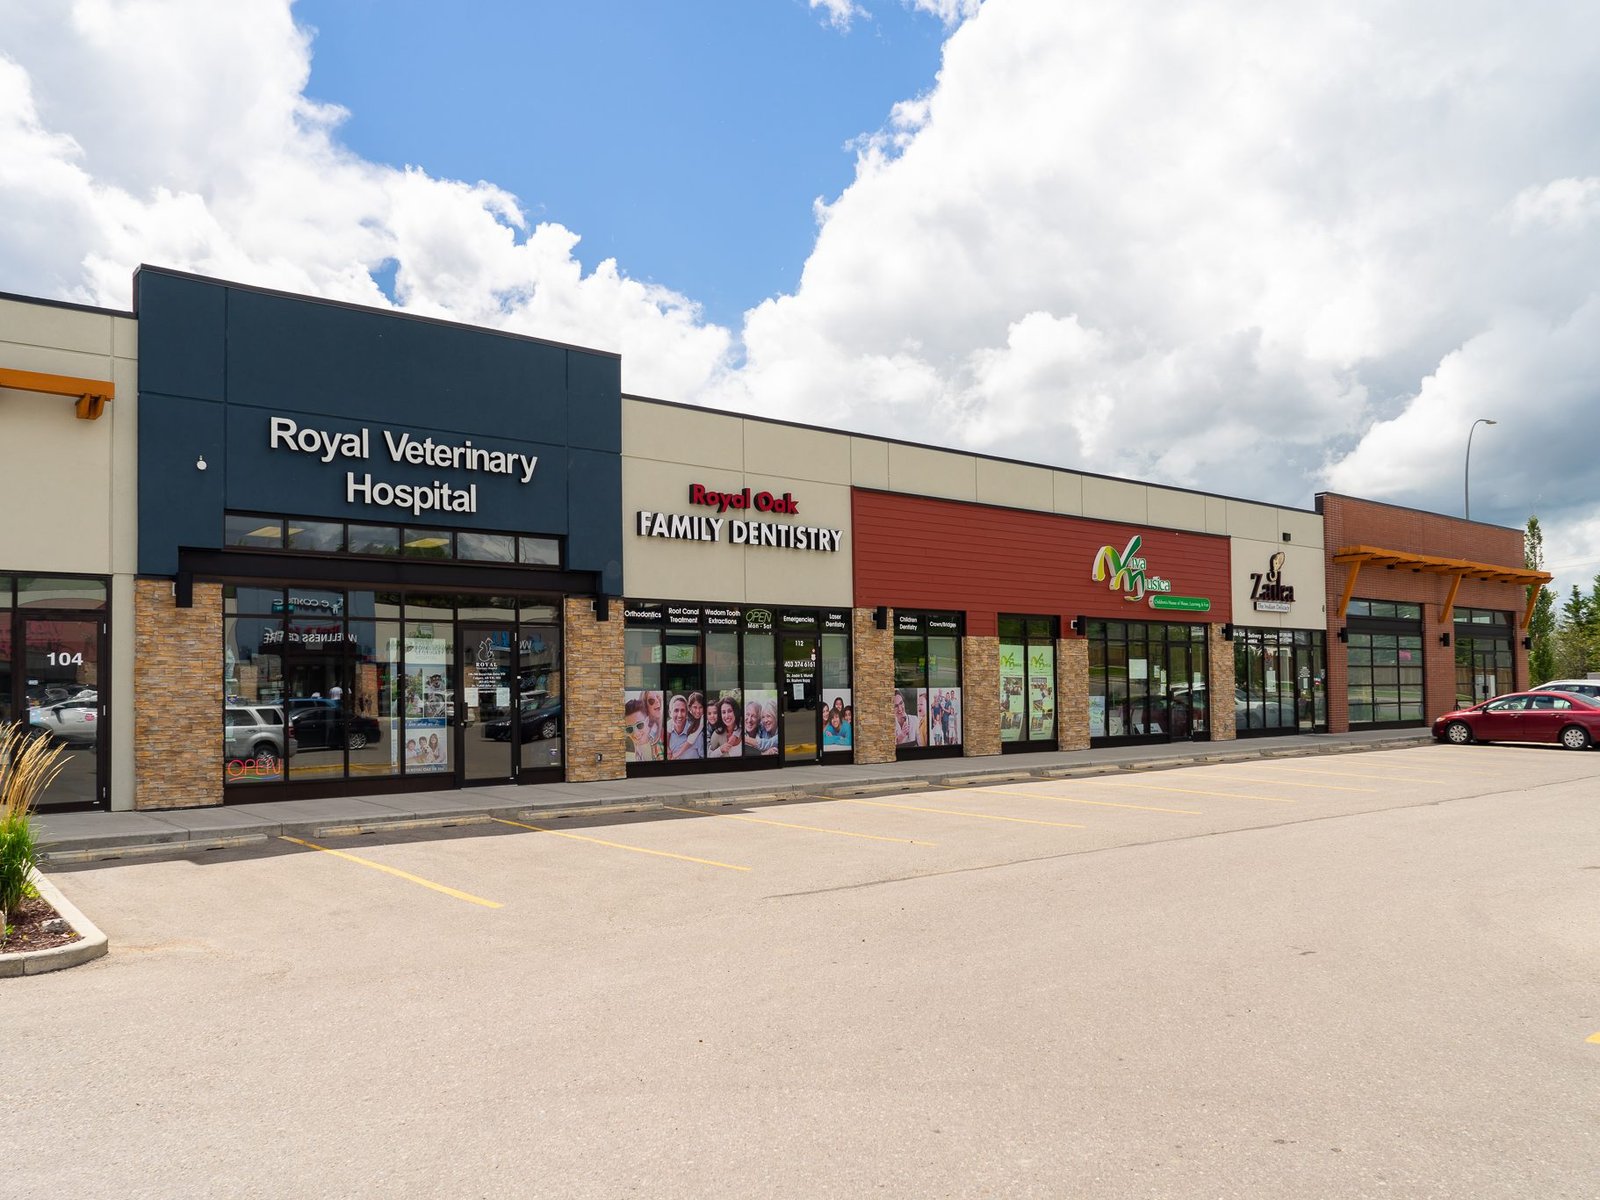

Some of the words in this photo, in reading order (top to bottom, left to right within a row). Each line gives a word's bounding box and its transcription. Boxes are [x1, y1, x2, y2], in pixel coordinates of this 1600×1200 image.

[270, 416, 370, 463] Royal
[383, 430, 538, 484] Veterinary
[346, 471, 477, 516] Hospital
[689, 483, 751, 514] Royal
[754, 492, 800, 514] Oak
[637, 511, 724, 542] FAMILY
[729, 519, 844, 552] DENTISTRY
[1250, 568, 1296, 603] Zaika
[624, 610, 662, 619] Orthodontics
[668, 607, 682, 615] Root
[682, 608, 700, 616] Canal
[704, 608, 726, 617] Wisdom
[726, 609, 741, 617] Tooth
[670, 616, 698, 624] Treatment
[708, 617, 737, 625] Extractions
[746, 611, 772, 623] OPEN
[783, 615, 815, 624] Emergencies
[825, 620, 846, 629] Dentistry
[899, 623, 918, 631] Dentistry
[46, 652, 84, 666] 104
[227, 758, 281, 777] OPEN
